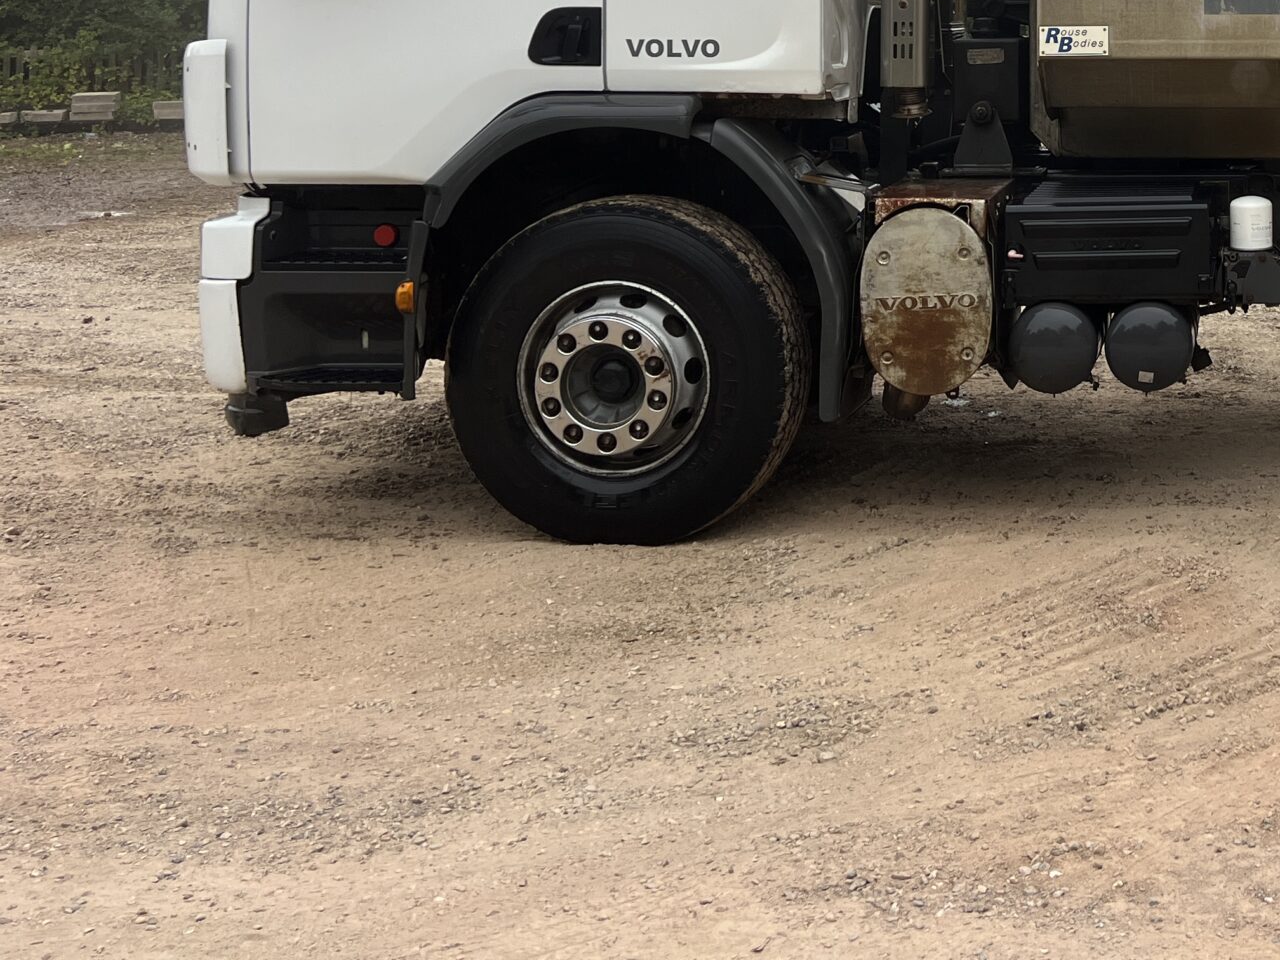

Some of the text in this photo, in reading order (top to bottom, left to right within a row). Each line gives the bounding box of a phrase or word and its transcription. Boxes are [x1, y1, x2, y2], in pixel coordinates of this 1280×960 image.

[1045, 27, 1088, 43] Rouse
[625, 39, 720, 58] VOLVO
[1058, 36, 1104, 52] Bodies
[875, 293, 976, 311] VOLVO
